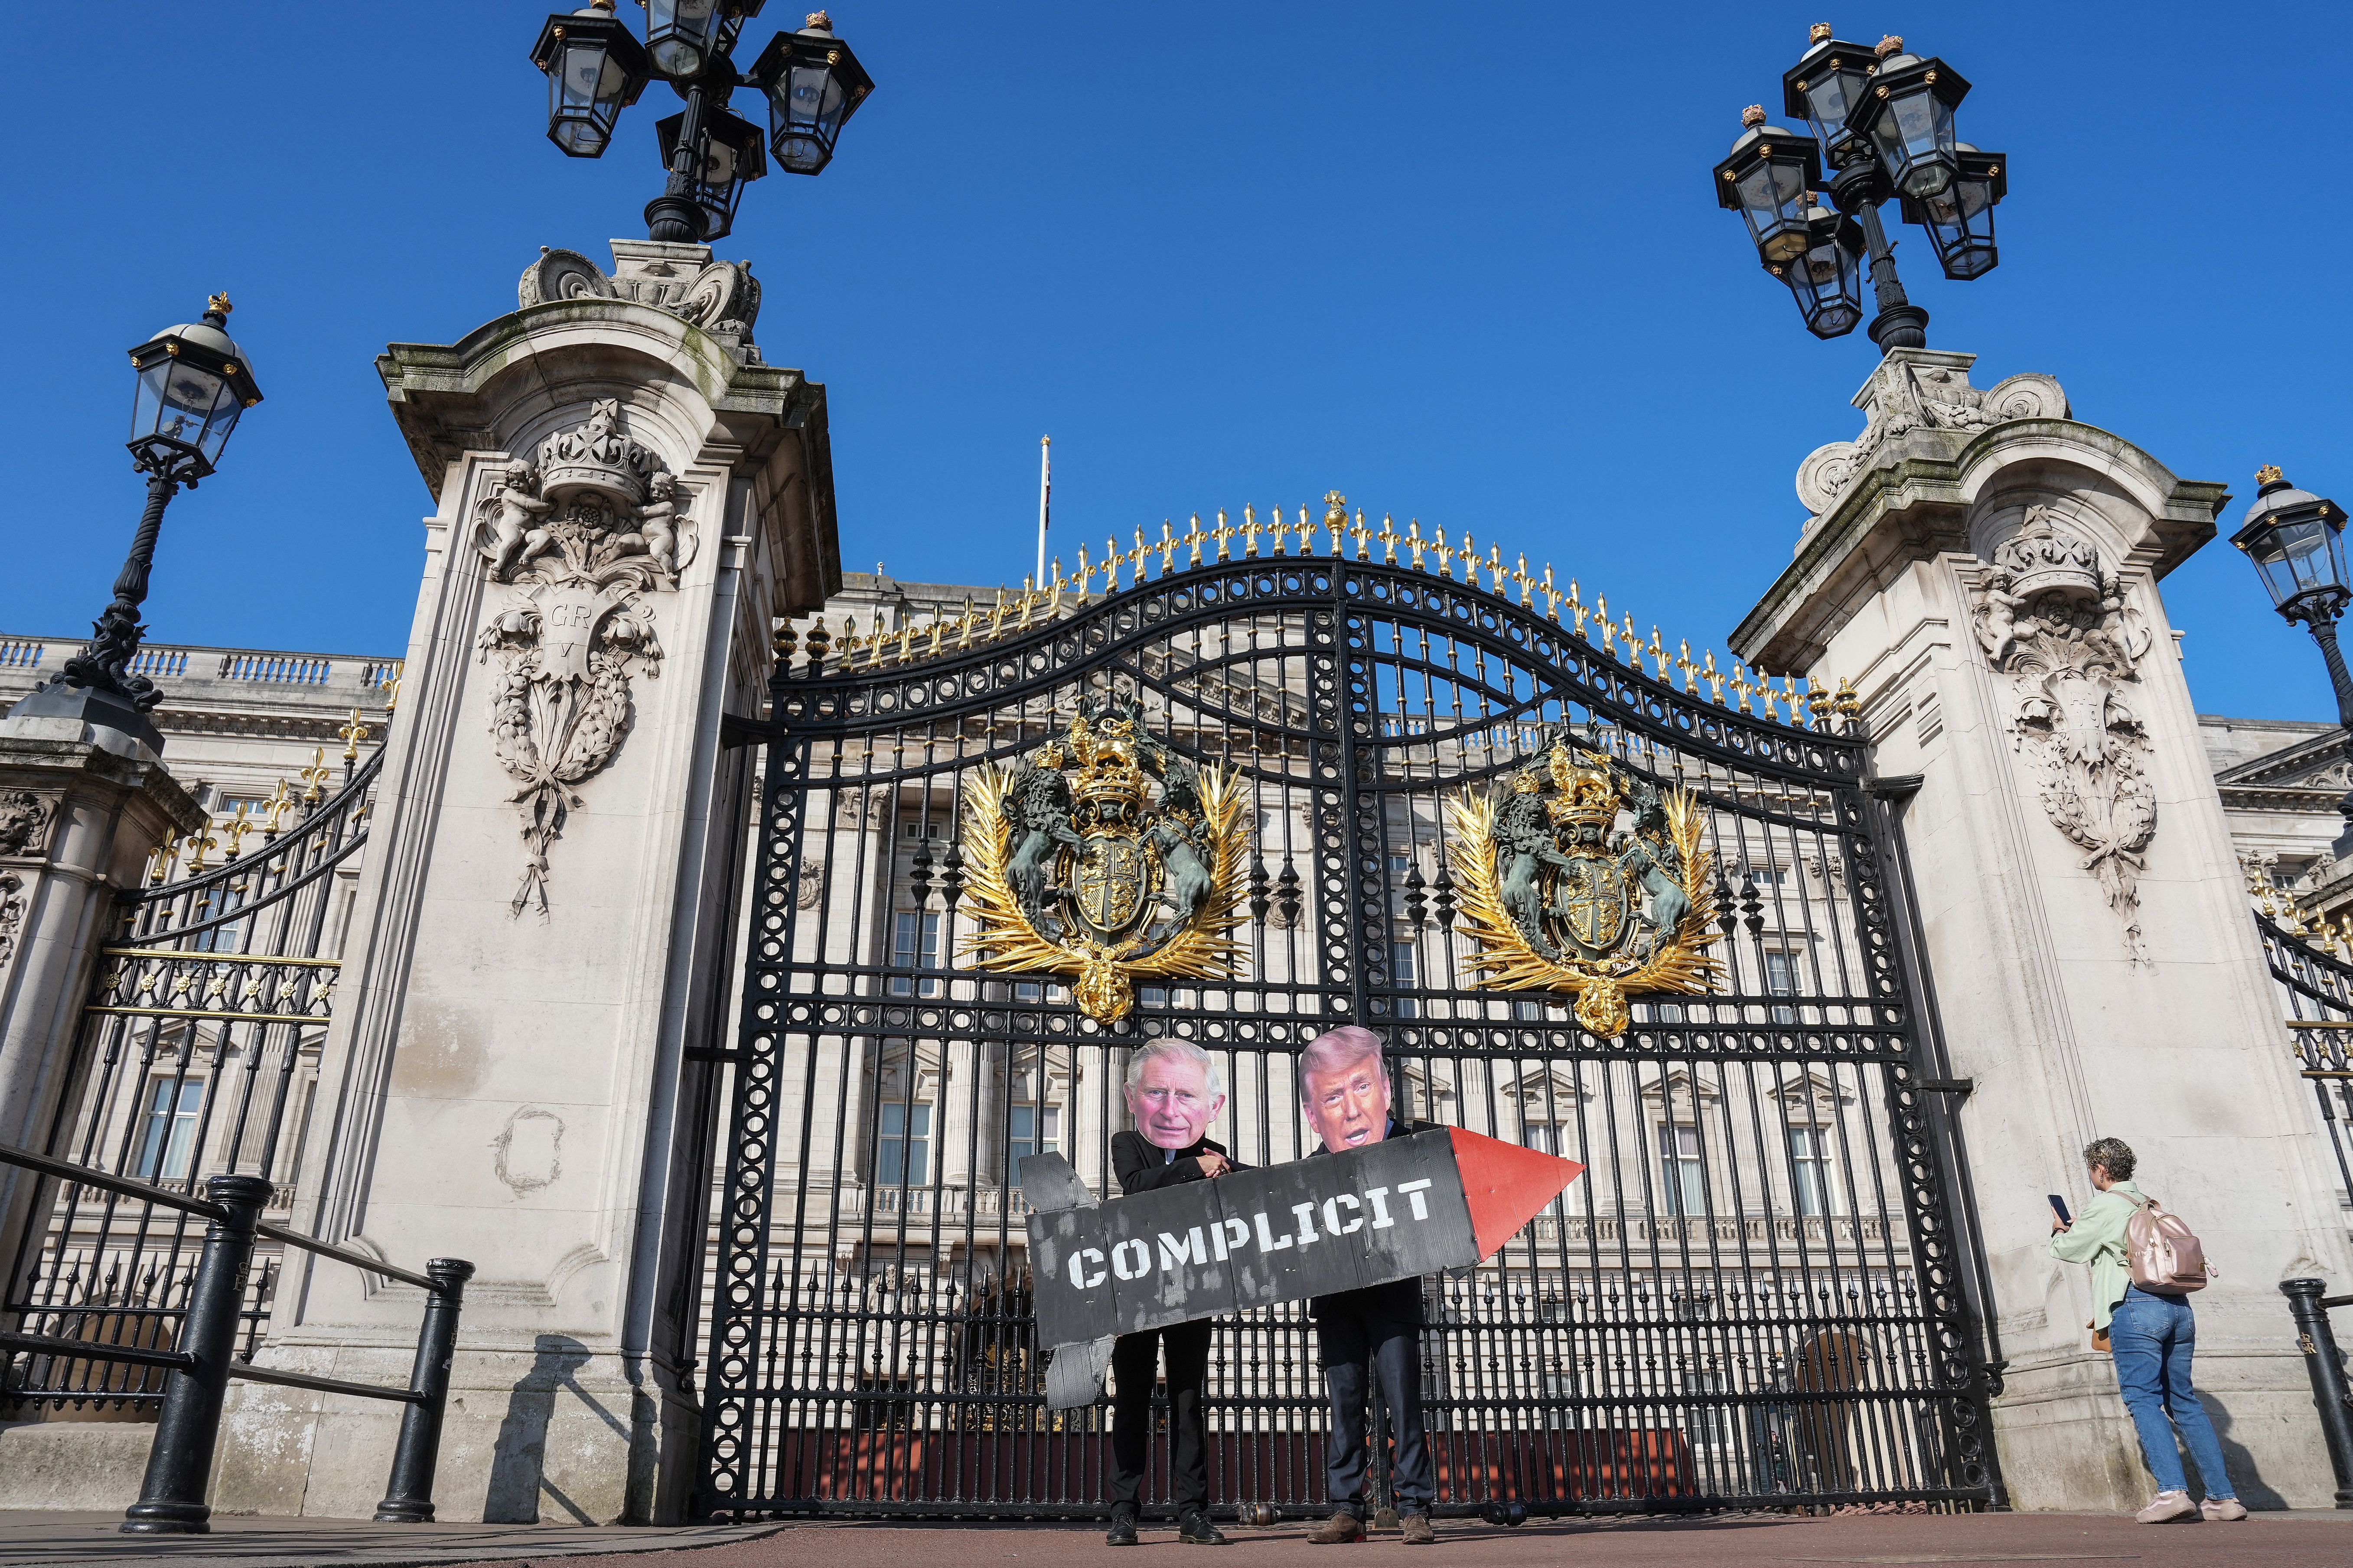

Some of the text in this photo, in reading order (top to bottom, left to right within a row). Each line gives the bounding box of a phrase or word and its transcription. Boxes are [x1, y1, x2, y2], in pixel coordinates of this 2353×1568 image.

[548, 603, 591, 629] GR
[557, 640, 574, 657] V
[1068, 1178, 1432, 1290] COMPLICIT
